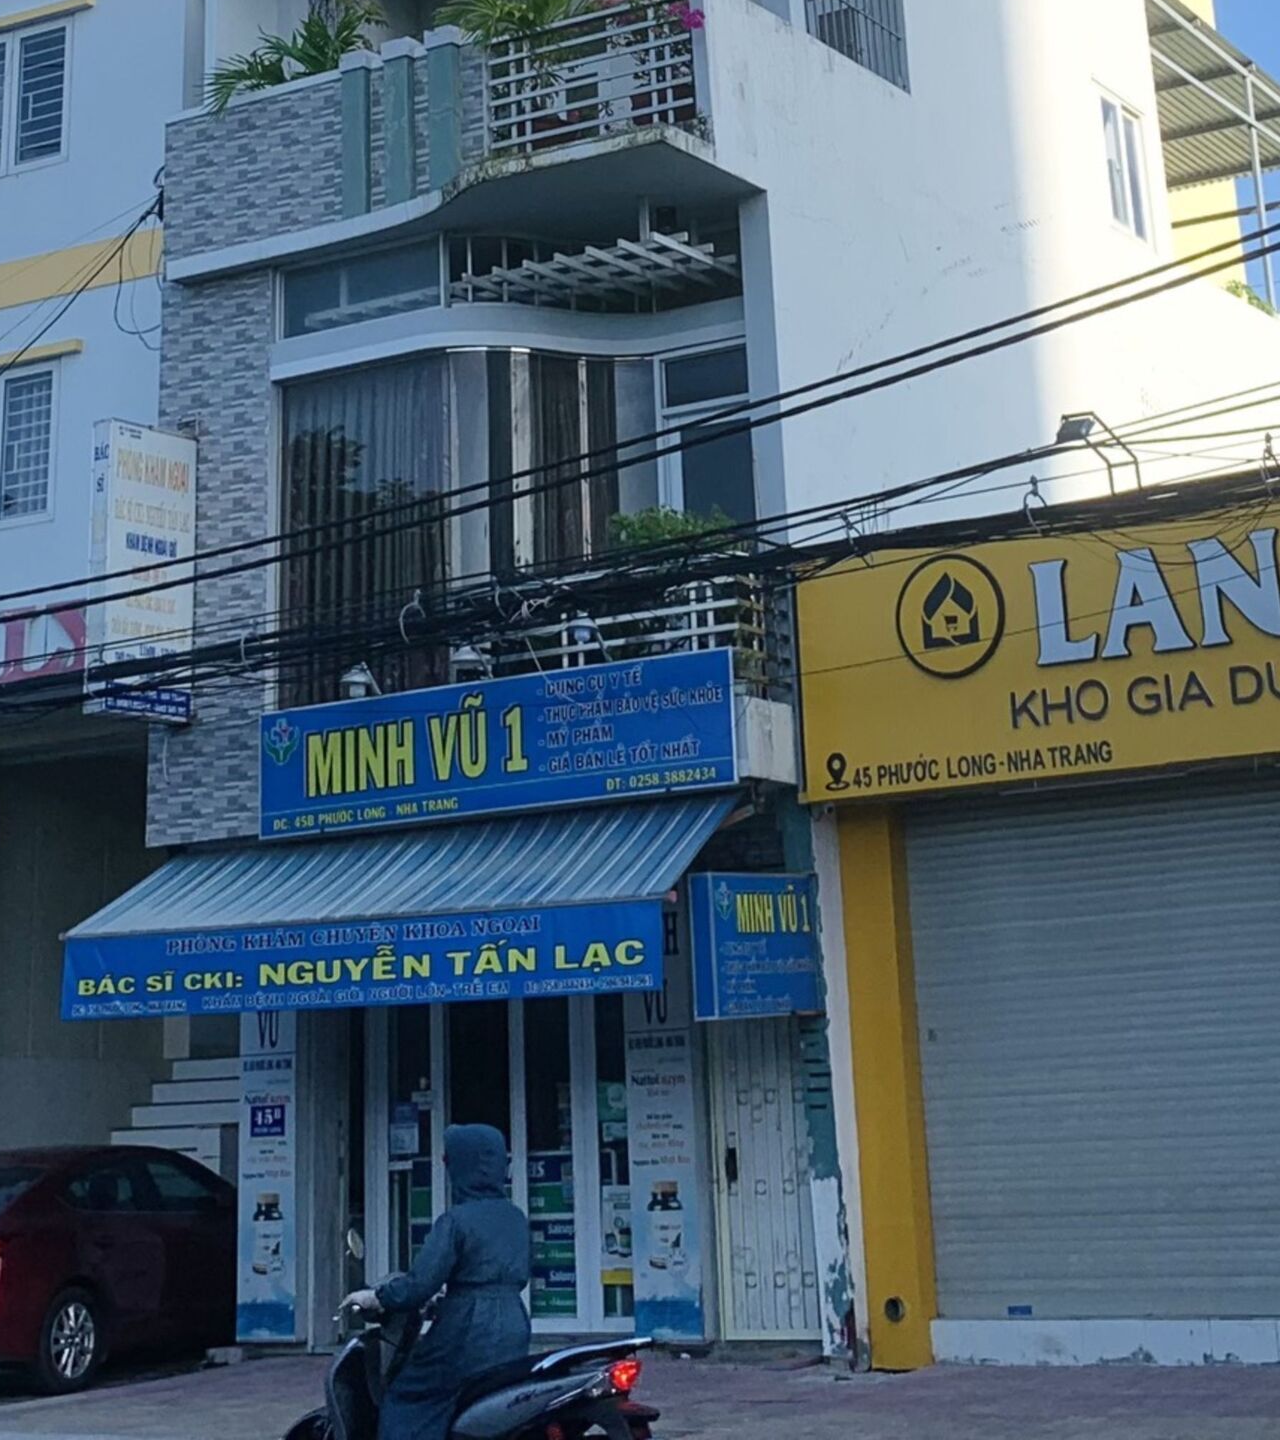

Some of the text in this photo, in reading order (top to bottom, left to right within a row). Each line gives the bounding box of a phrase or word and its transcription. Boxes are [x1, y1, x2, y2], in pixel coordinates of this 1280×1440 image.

[610, 672, 622, 688] Y
[624, 662, 645, 686] TẾ
[661, 687, 686, 708] SỨC
[1009, 679, 1110, 730] KHO
[1126, 669, 1215, 717] GIA
[304, 691, 529, 799] MINH VŨ 1
[547, 718, 614, 748] MỸ PHẨM
[548, 734, 701, 774] GIÁ BÁN LẺ TỐT NHẤT
[852, 740, 1113, 790] 45 PHƯỚC TRANG
[629, 771, 660, 788] 0258
[664, 766, 717, 784] 3882434
[294, 814, 315, 829] 45B
[357, 806, 387, 821] LONG
[396, 803, 419, 816] NHA
[422, 797, 459, 812] TRANG
[736, 884, 811, 934] MINH VŨ 1
[166, 914, 541, 956] PHÒNG KHÁM CHUYÊN KHOA NGOẠI
[77, 938, 645, 996] BÁC SĨ CKI: NGUYỄN TẤN LẠC
